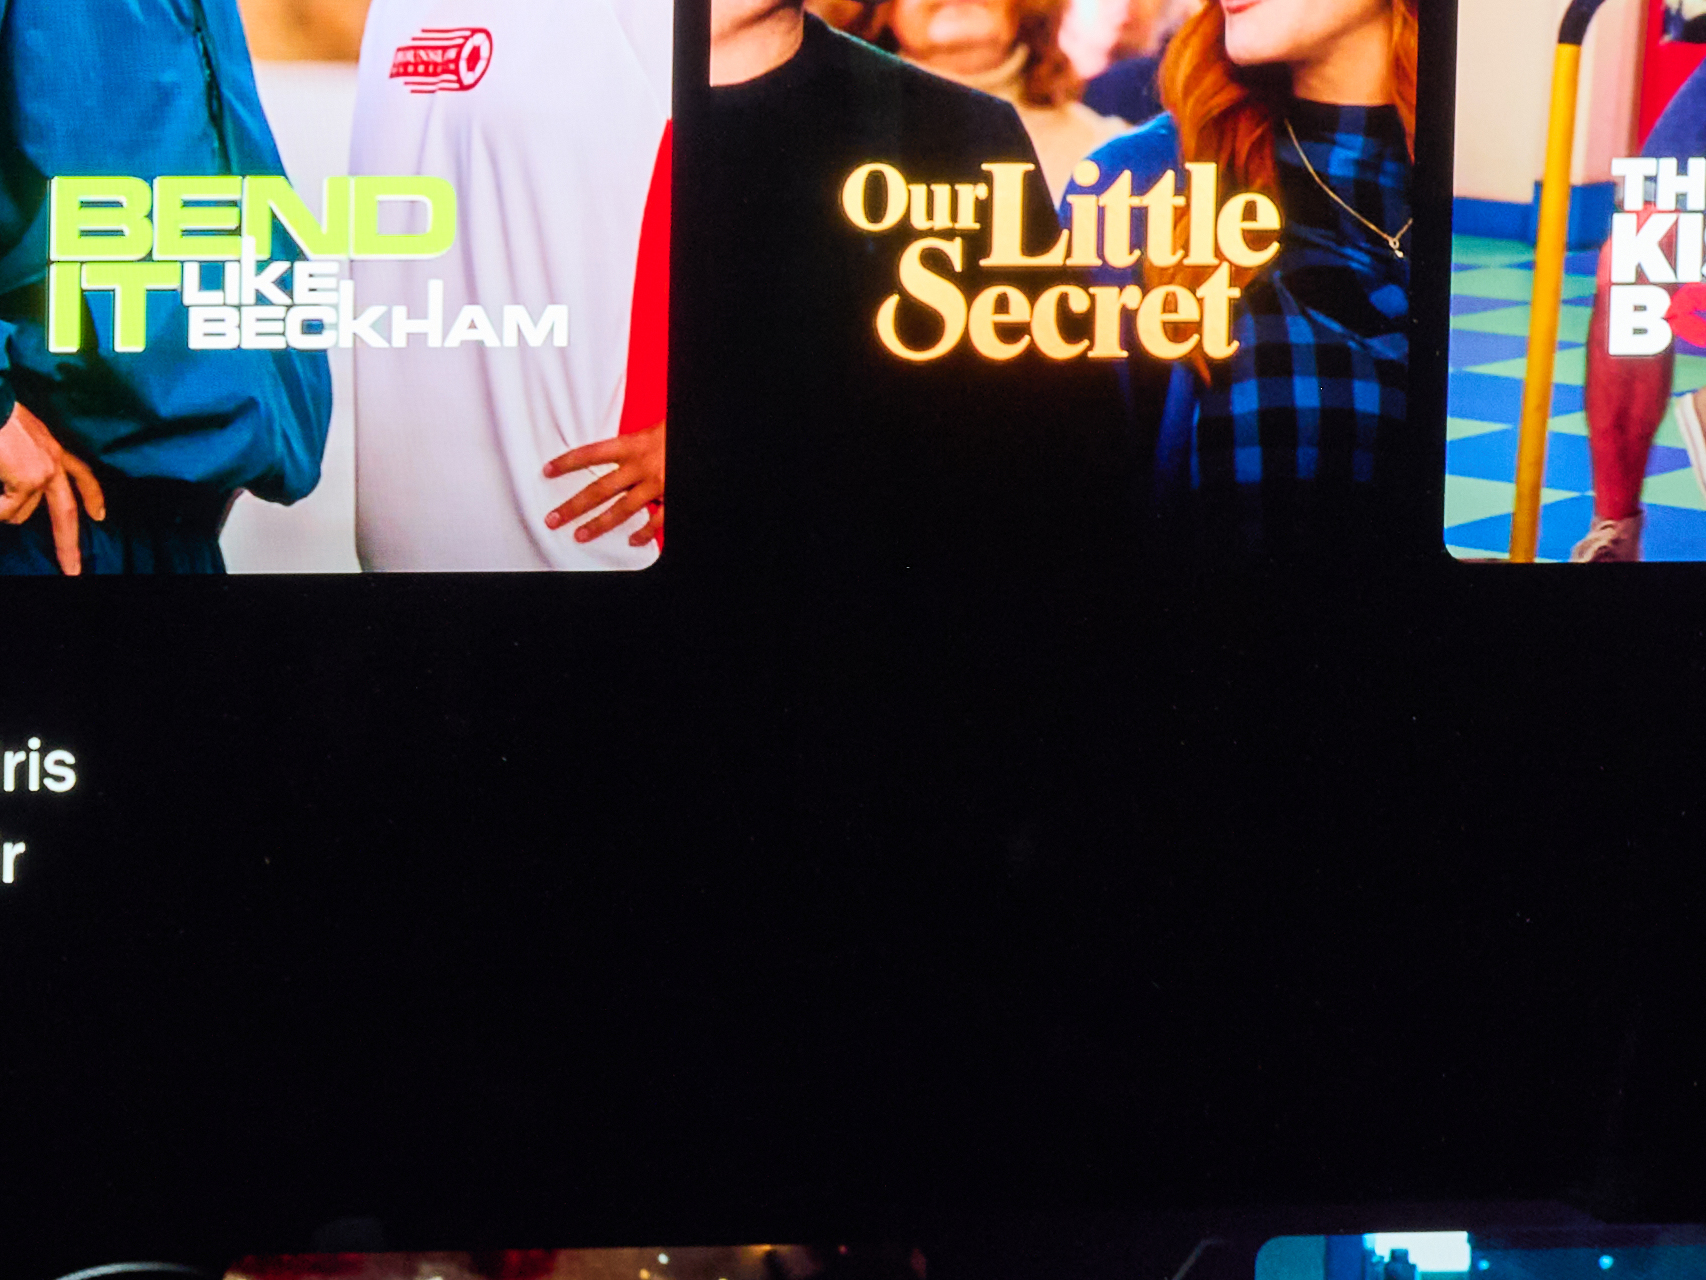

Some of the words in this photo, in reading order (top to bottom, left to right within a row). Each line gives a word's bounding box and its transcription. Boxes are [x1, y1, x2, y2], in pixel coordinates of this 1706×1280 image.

[49, 175, 457, 261] BEND
[841, 163, 988, 232] Our
[980, 159, 1282, 267] Little
[49, 261, 181, 353] IT
[182, 237, 341, 307] LIKE
[188, 279, 570, 349] BECKHAM
[876, 237, 1242, 361] Secret
